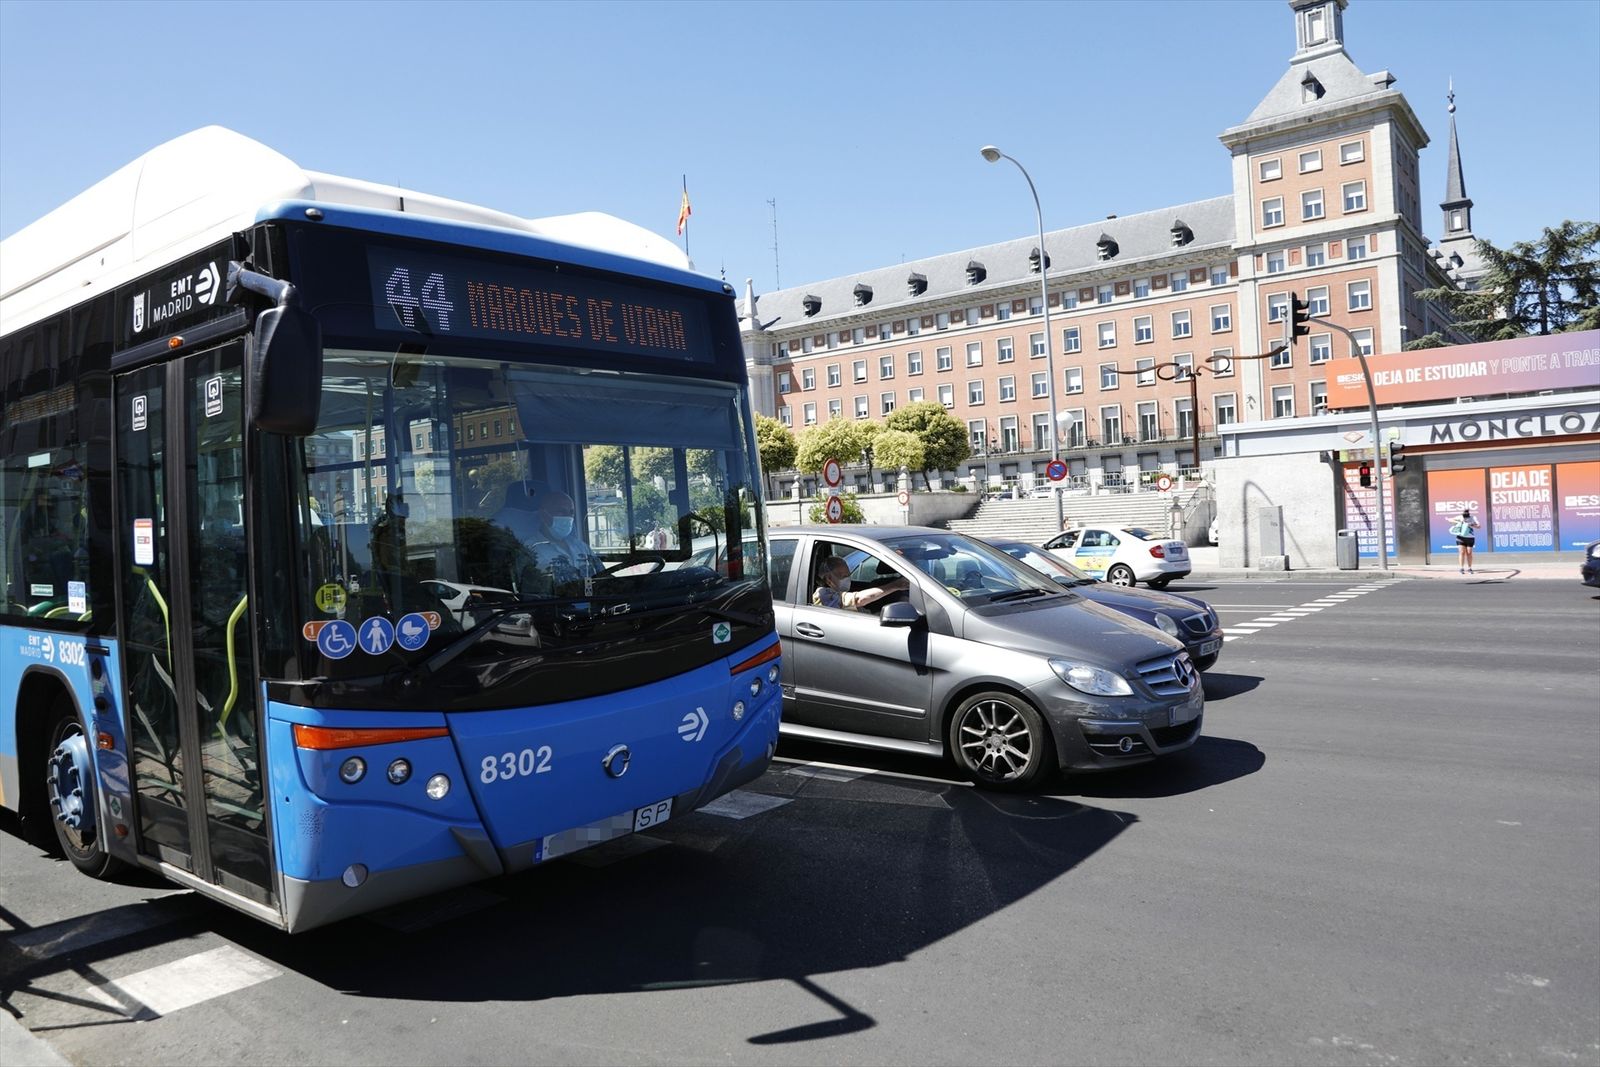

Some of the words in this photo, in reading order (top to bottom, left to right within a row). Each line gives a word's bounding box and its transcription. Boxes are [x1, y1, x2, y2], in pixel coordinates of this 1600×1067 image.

[171, 274, 193, 297] EMT
[153, 294, 193, 323] MADRID
[385, 267, 454, 330] 44
[467, 280, 582, 338] MARQUES
[587, 299, 618, 342] DE
[1373, 370, 1404, 386] DEJA
[1406, 368, 1422, 383] DE
[1425, 360, 1487, 381] ESTUDIAR
[1489, 360, 1500, 375] Y
[1501, 354, 1547, 374] PONTE
[1549, 353, 1560, 370] A
[1491, 471, 1527, 488] DEJA
[1529, 470, 1549, 487] DE
[1492, 489, 1551, 504] ESTUDIAR
[1446, 501, 1479, 511] ESIC
[1492, 506, 1501, 520] Y
[1502, 505, 1539, 520] PONTE
[1541, 504, 1551, 519] A
[1494, 534, 1508, 547] TU
[1510, 533, 1552, 547] FUTURO
[430, 614, 437, 625] 2
[309, 624, 314, 636] 1
[28, 635, 41, 646] EMT
[20, 645, 42, 658] MADRID
[59, 640, 85, 666] 8302
[480, 745, 552, 784] 8302
